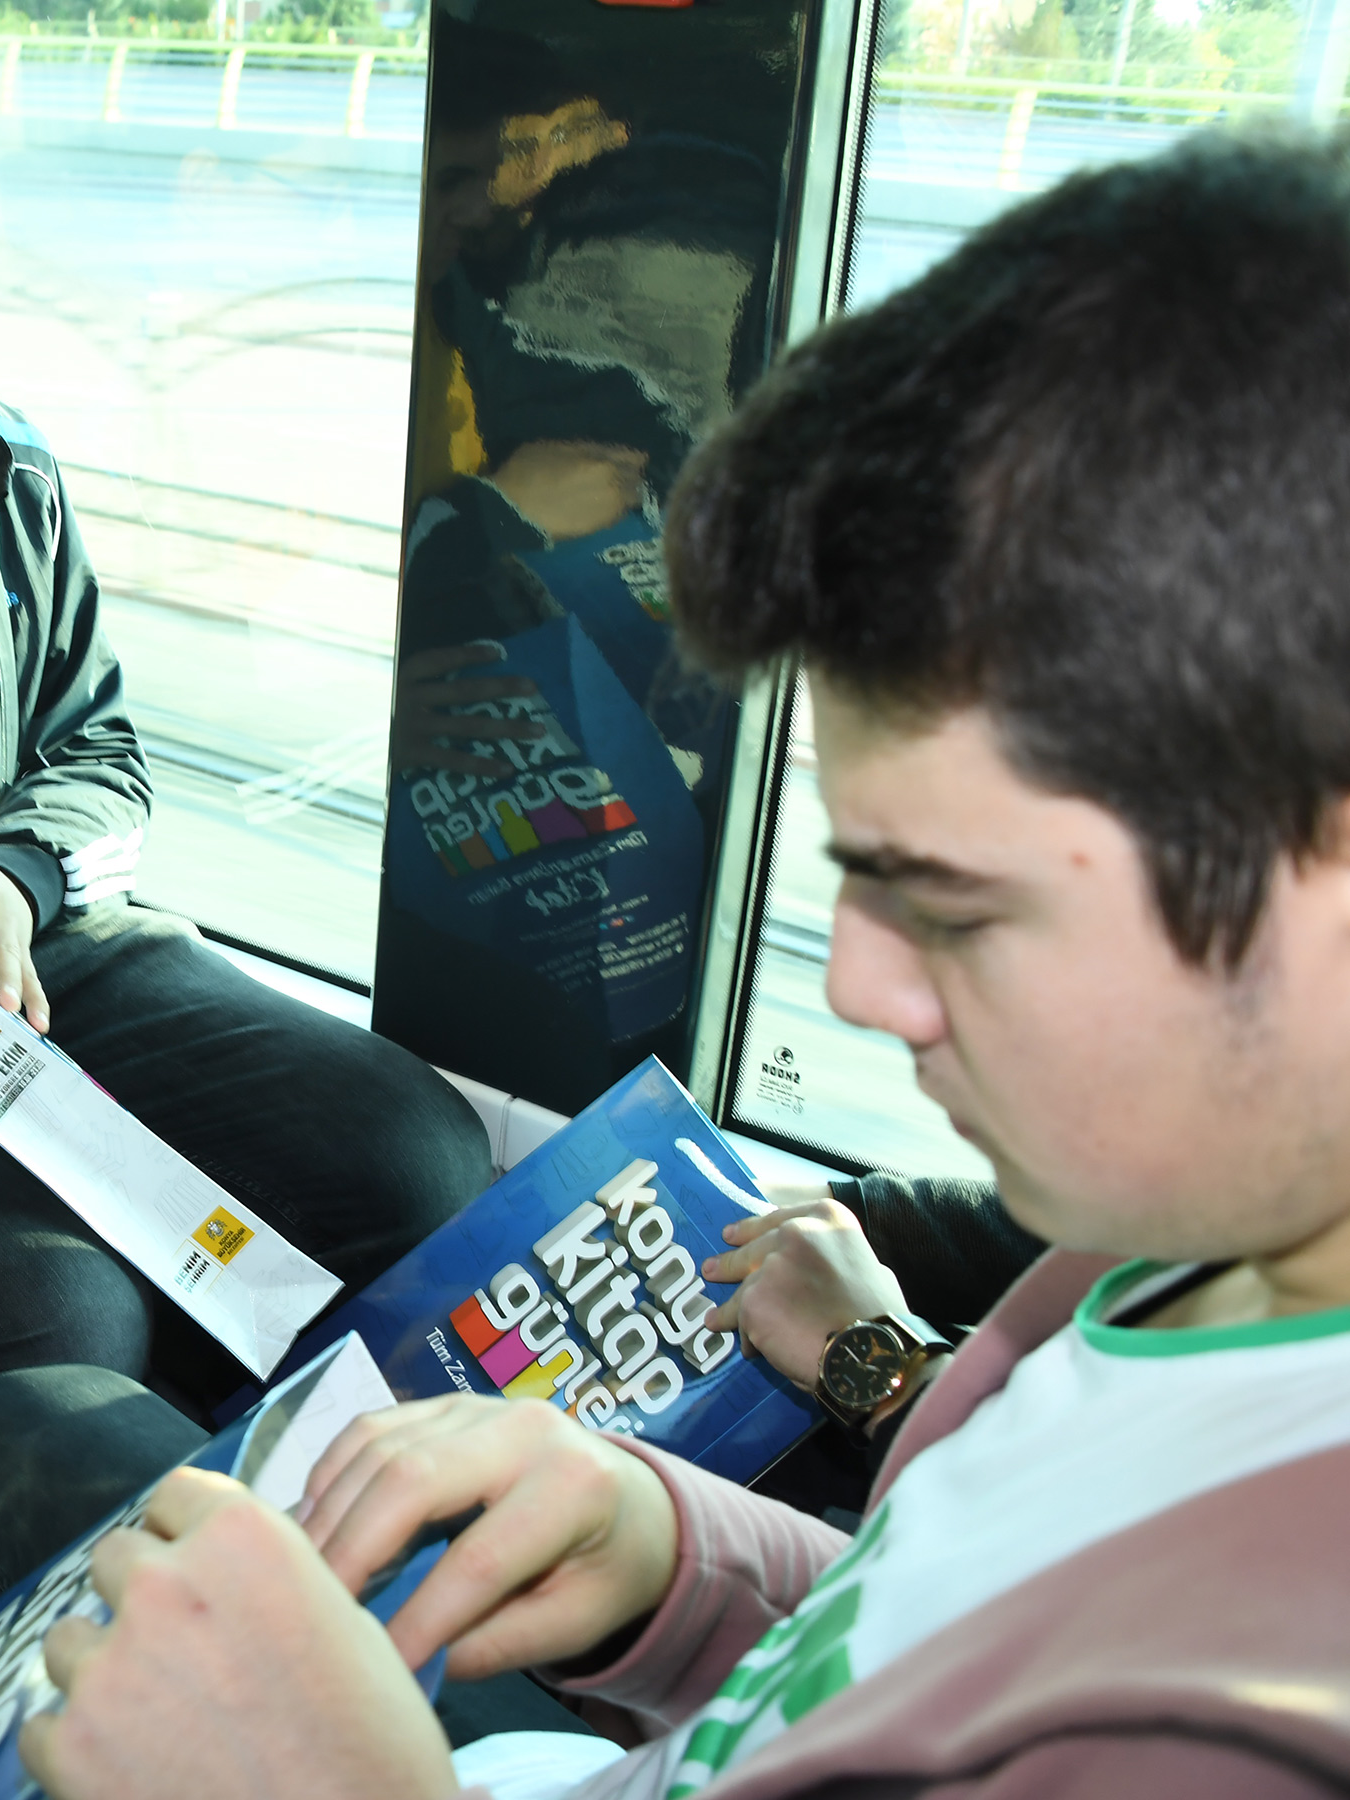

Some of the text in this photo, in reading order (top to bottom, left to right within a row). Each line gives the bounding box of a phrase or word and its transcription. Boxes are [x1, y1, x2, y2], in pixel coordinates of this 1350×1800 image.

[425, 1326, 453, 1366] Tüm
[532, 1201, 684, 1415] kitap
[595, 1158, 735, 1374] konya
